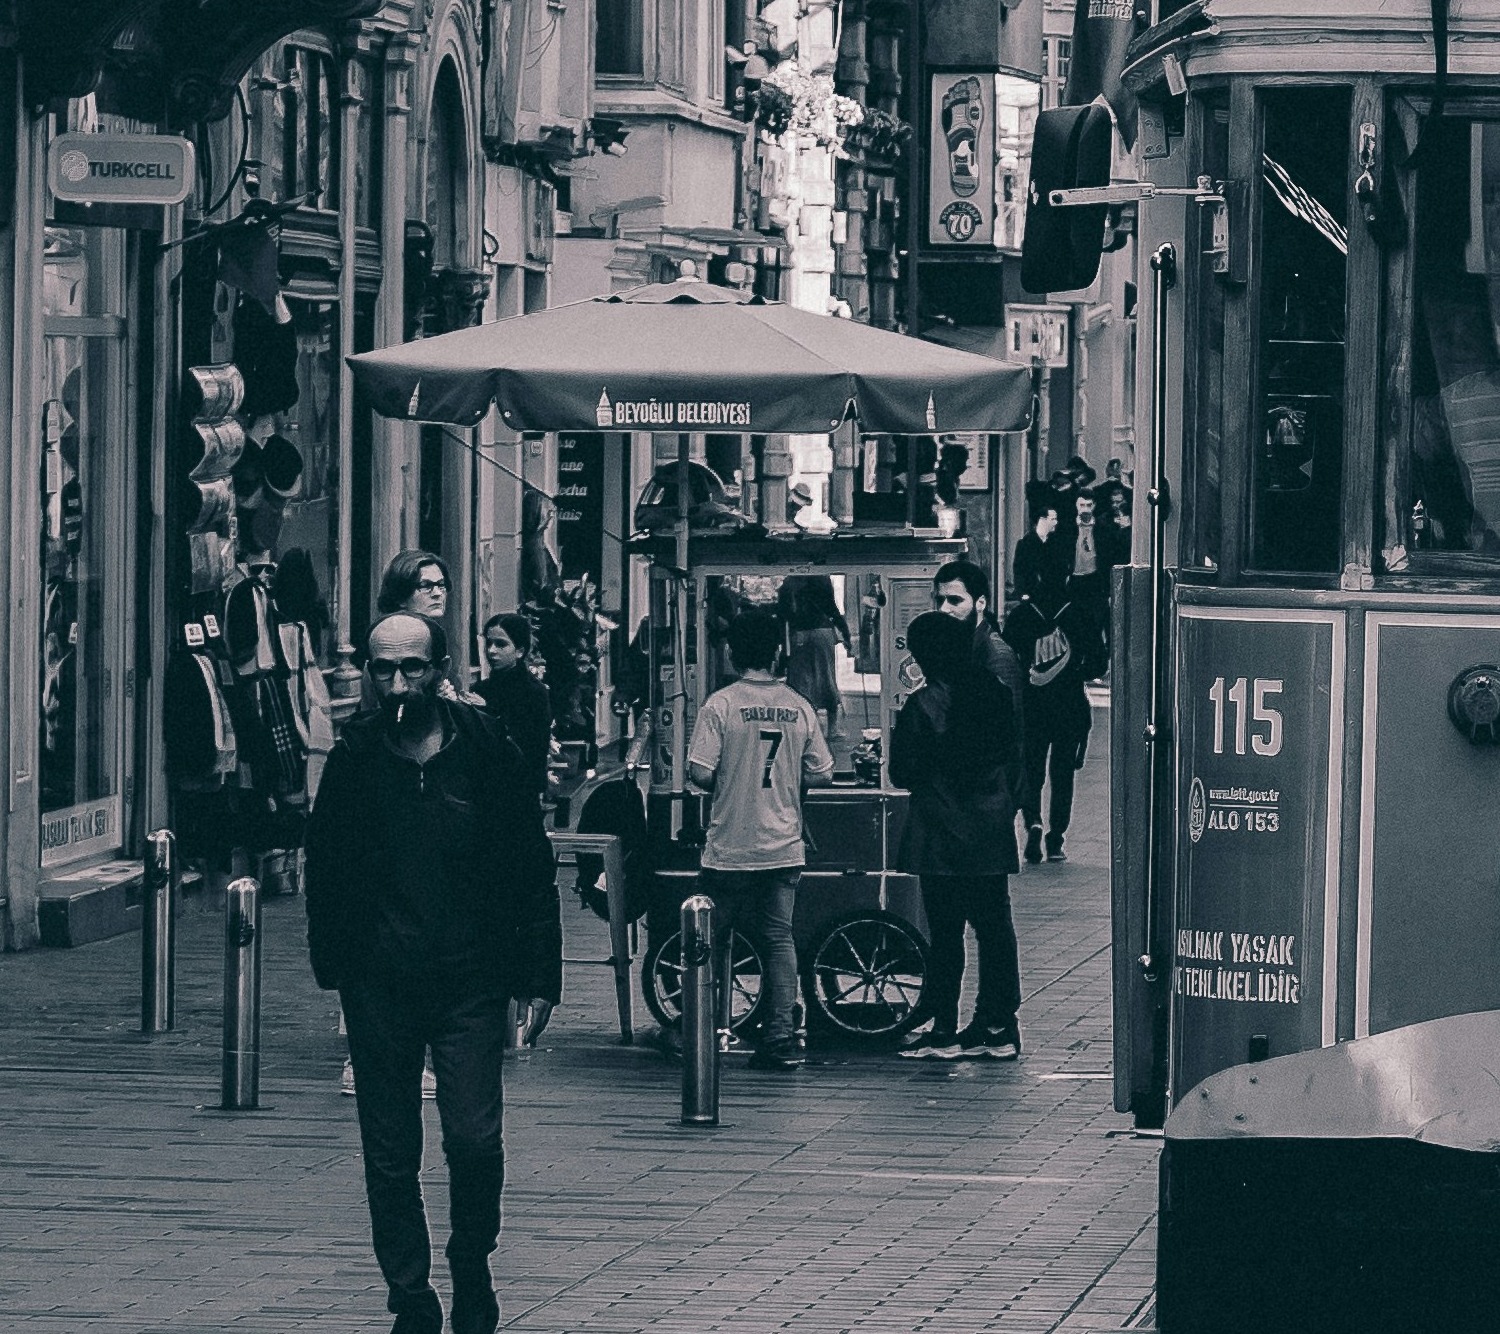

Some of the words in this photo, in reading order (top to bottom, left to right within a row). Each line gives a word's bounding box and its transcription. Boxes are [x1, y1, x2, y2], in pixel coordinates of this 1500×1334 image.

[88, 159, 177, 181] TURKCELL
[949, 213, 973, 235] 70
[615, 398, 674, 424] BEYOĞLU
[677, 401, 750, 425] BELEDİYESİ
[1208, 676, 1284, 757] 115
[759, 730, 783, 789] 7
[1207, 809, 1240, 831] ALO
[1244, 811, 1280, 832] 153
[1230, 932, 1295, 966] YASAK
[1185, 965, 1300, 1004] TEHLİKELİDİR
